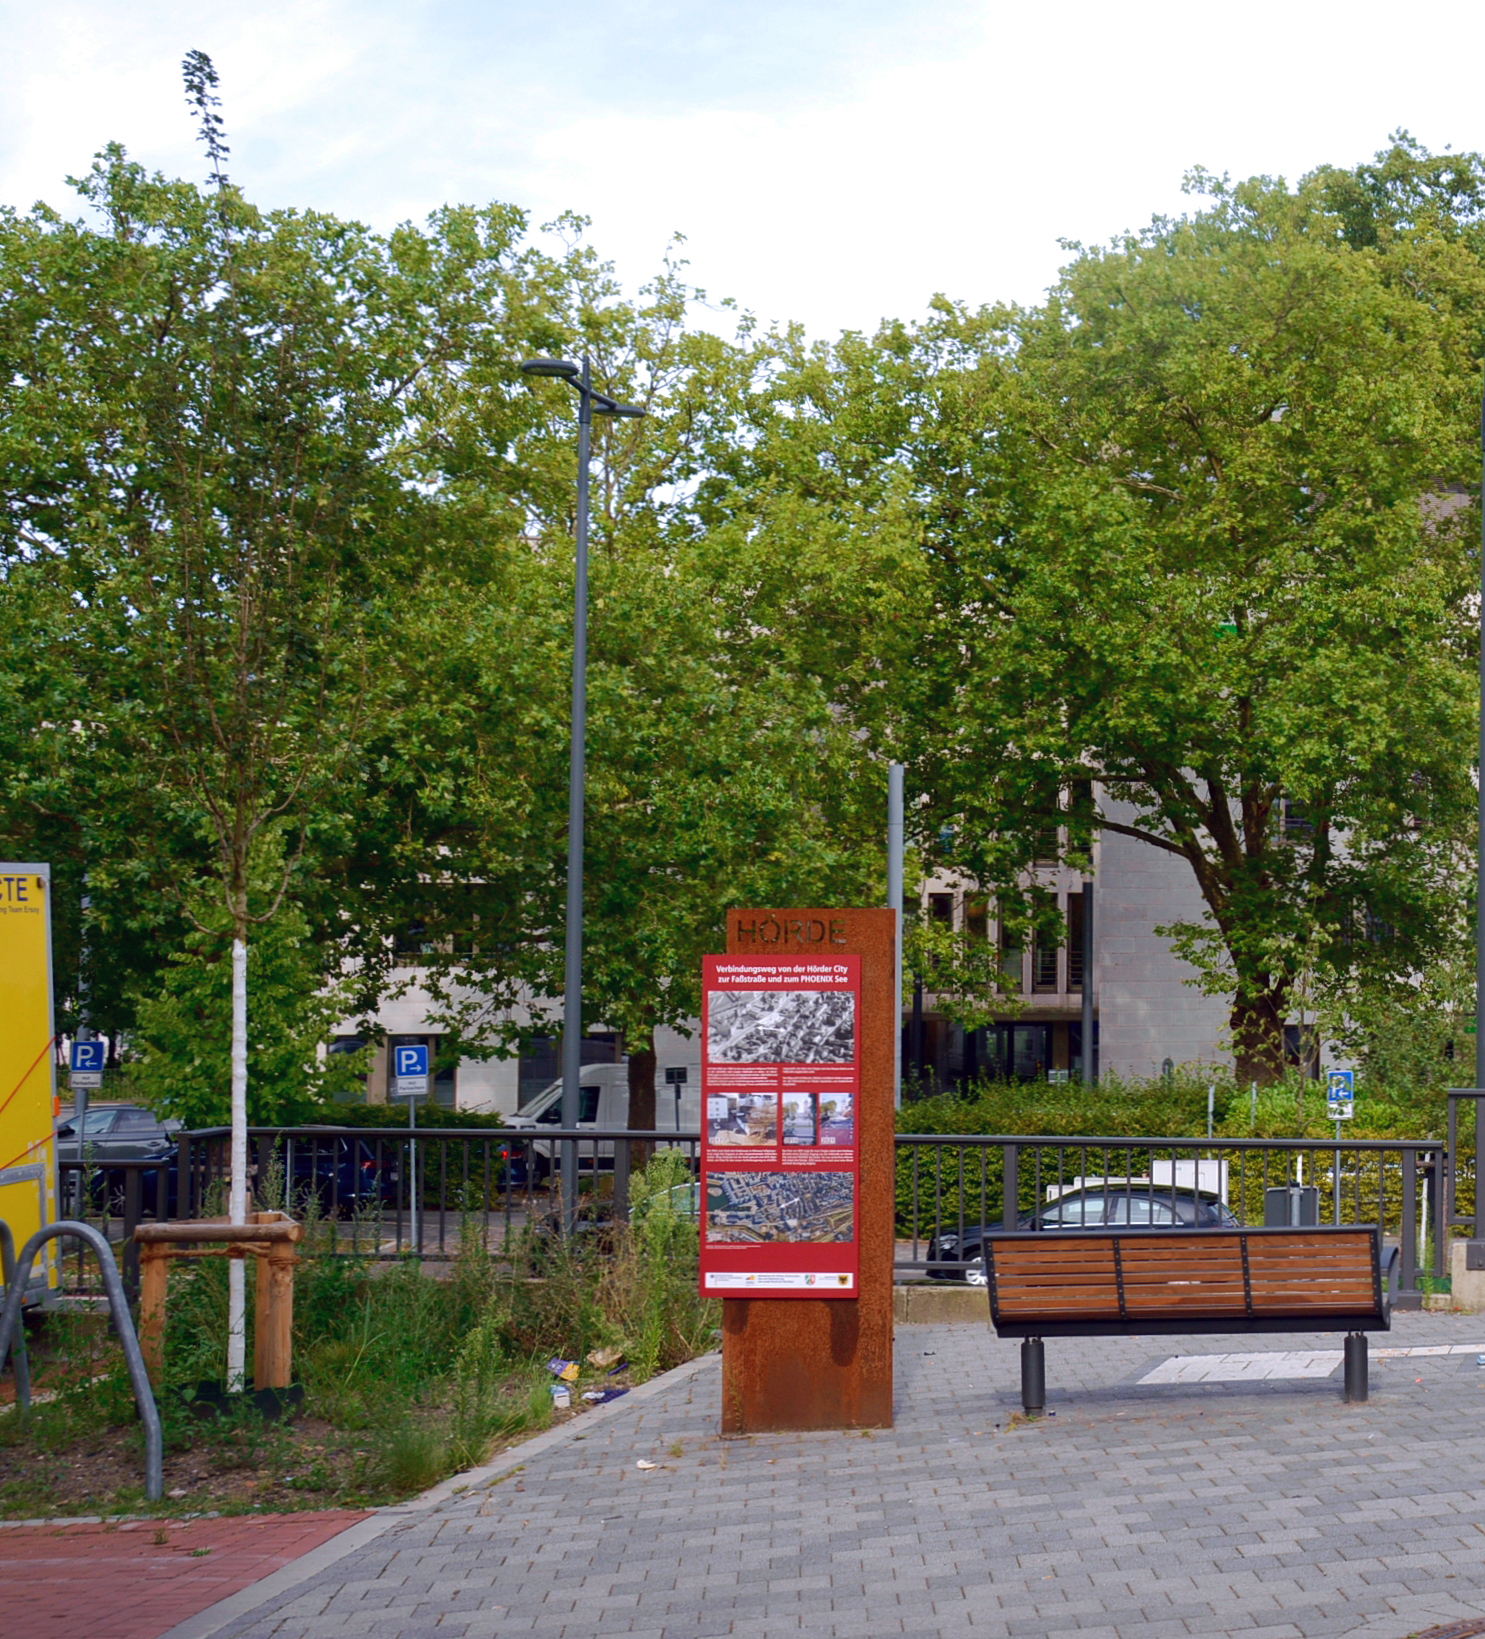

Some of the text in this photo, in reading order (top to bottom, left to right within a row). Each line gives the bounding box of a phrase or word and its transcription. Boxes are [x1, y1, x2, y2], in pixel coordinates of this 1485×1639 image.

[737, 914, 847, 944] HÖRDE
[716, 965, 777, 974] Verbindungsweg
[834, 965, 848, 974] City
[731, 975, 766, 983] Faßstraße
[768, 975, 782, 983] und
[801, 975, 833, 983] PHOENIX
[835, 975, 848, 983] See
[76, 1046, 94, 1067] P
[401, 1050, 418, 1072] P
